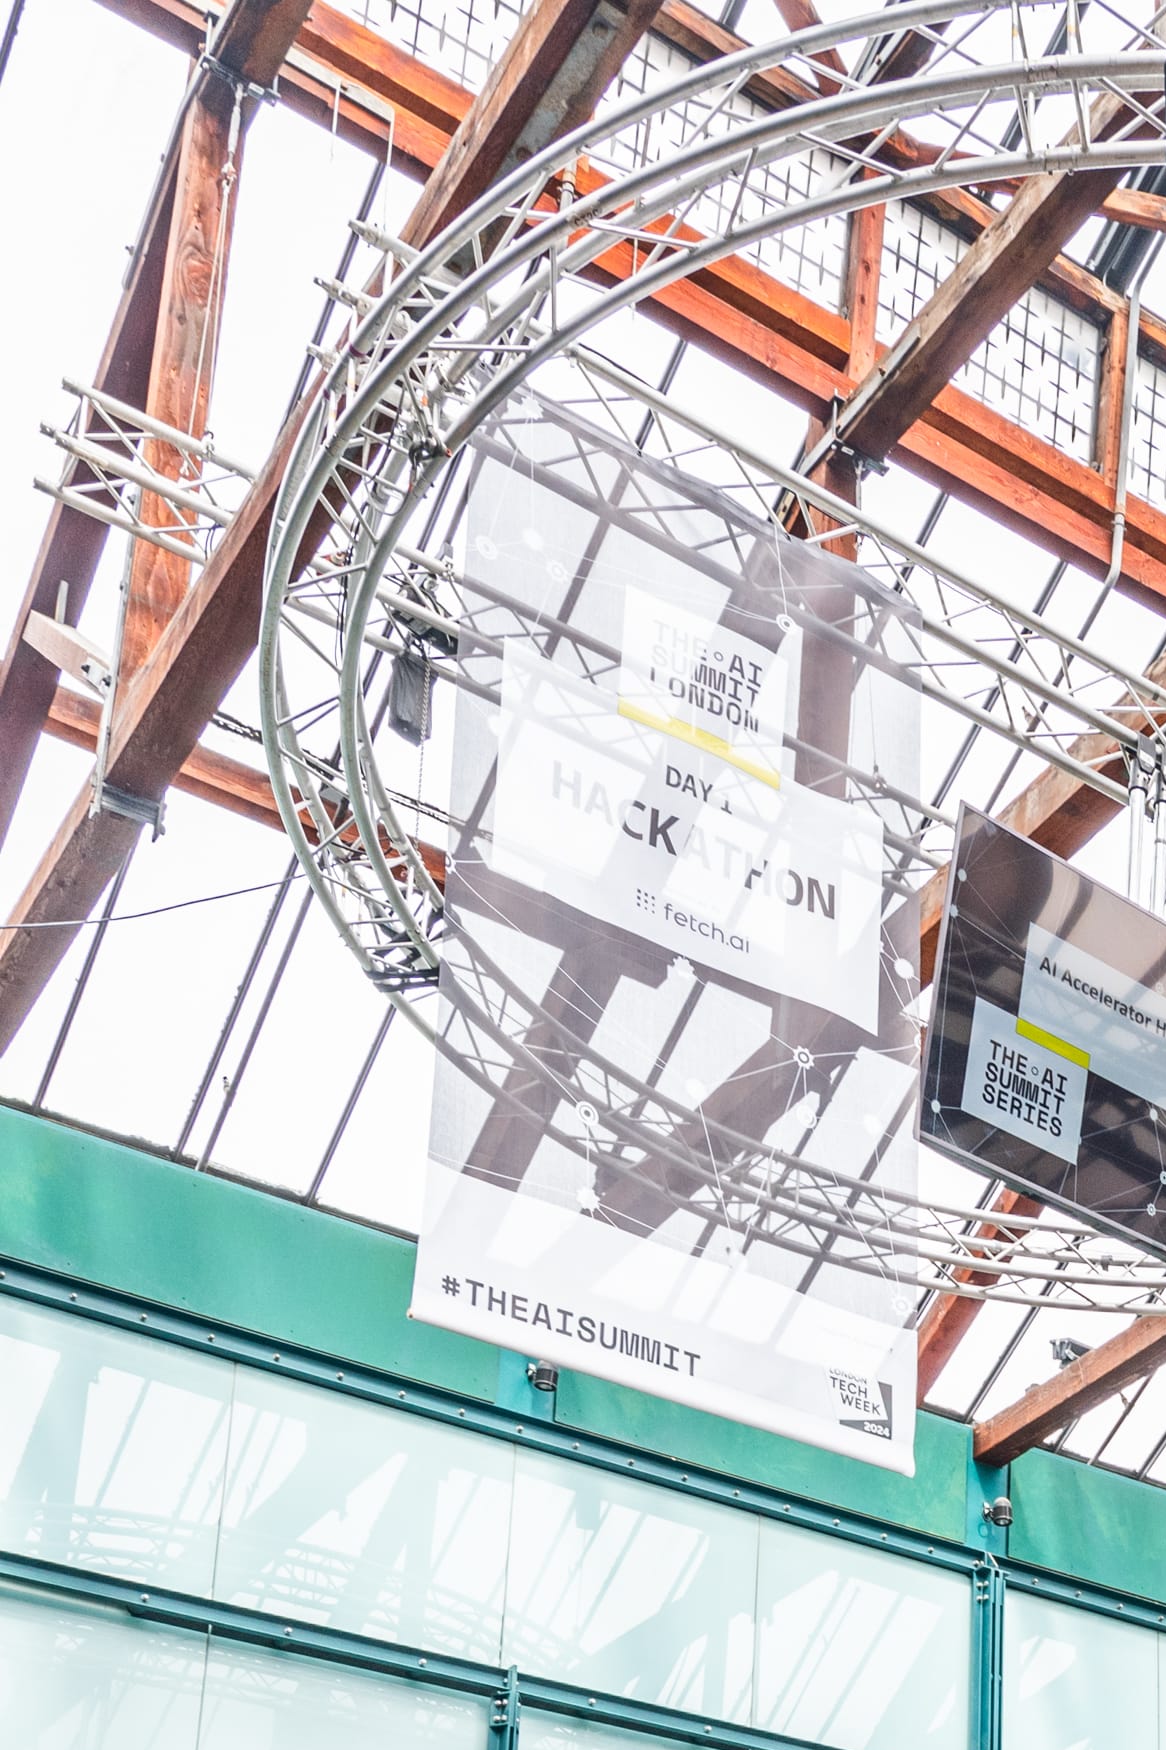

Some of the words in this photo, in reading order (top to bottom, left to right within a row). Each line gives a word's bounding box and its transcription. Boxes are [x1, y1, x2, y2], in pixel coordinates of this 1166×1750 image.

[651, 643, 759, 707] SUMMIT
[652, 618, 710, 662] THE
[728, 653, 763, 688] AI
[650, 666, 759, 733] LONDON
[665, 764, 713, 803] DAY
[551, 759, 836, 920] HACKATHON
[663, 902, 750, 953] fetch.ai
[1039, 956, 1058, 978] AI
[1060, 968, 1153, 1029] Accelerator
[984, 1061, 1066, 1116] SUMMIT
[989, 1038, 1029, 1077] THE
[1041, 1067, 1068, 1097] AI
[982, 1083, 1063, 1138] SERIES
[441, 1274, 702, 1377] #THEAISUMMIT
[829, 1375, 868, 1399] TECH
[840, 1391, 881, 1417] WEEK
[862, 1421, 891, 1438] 2024
